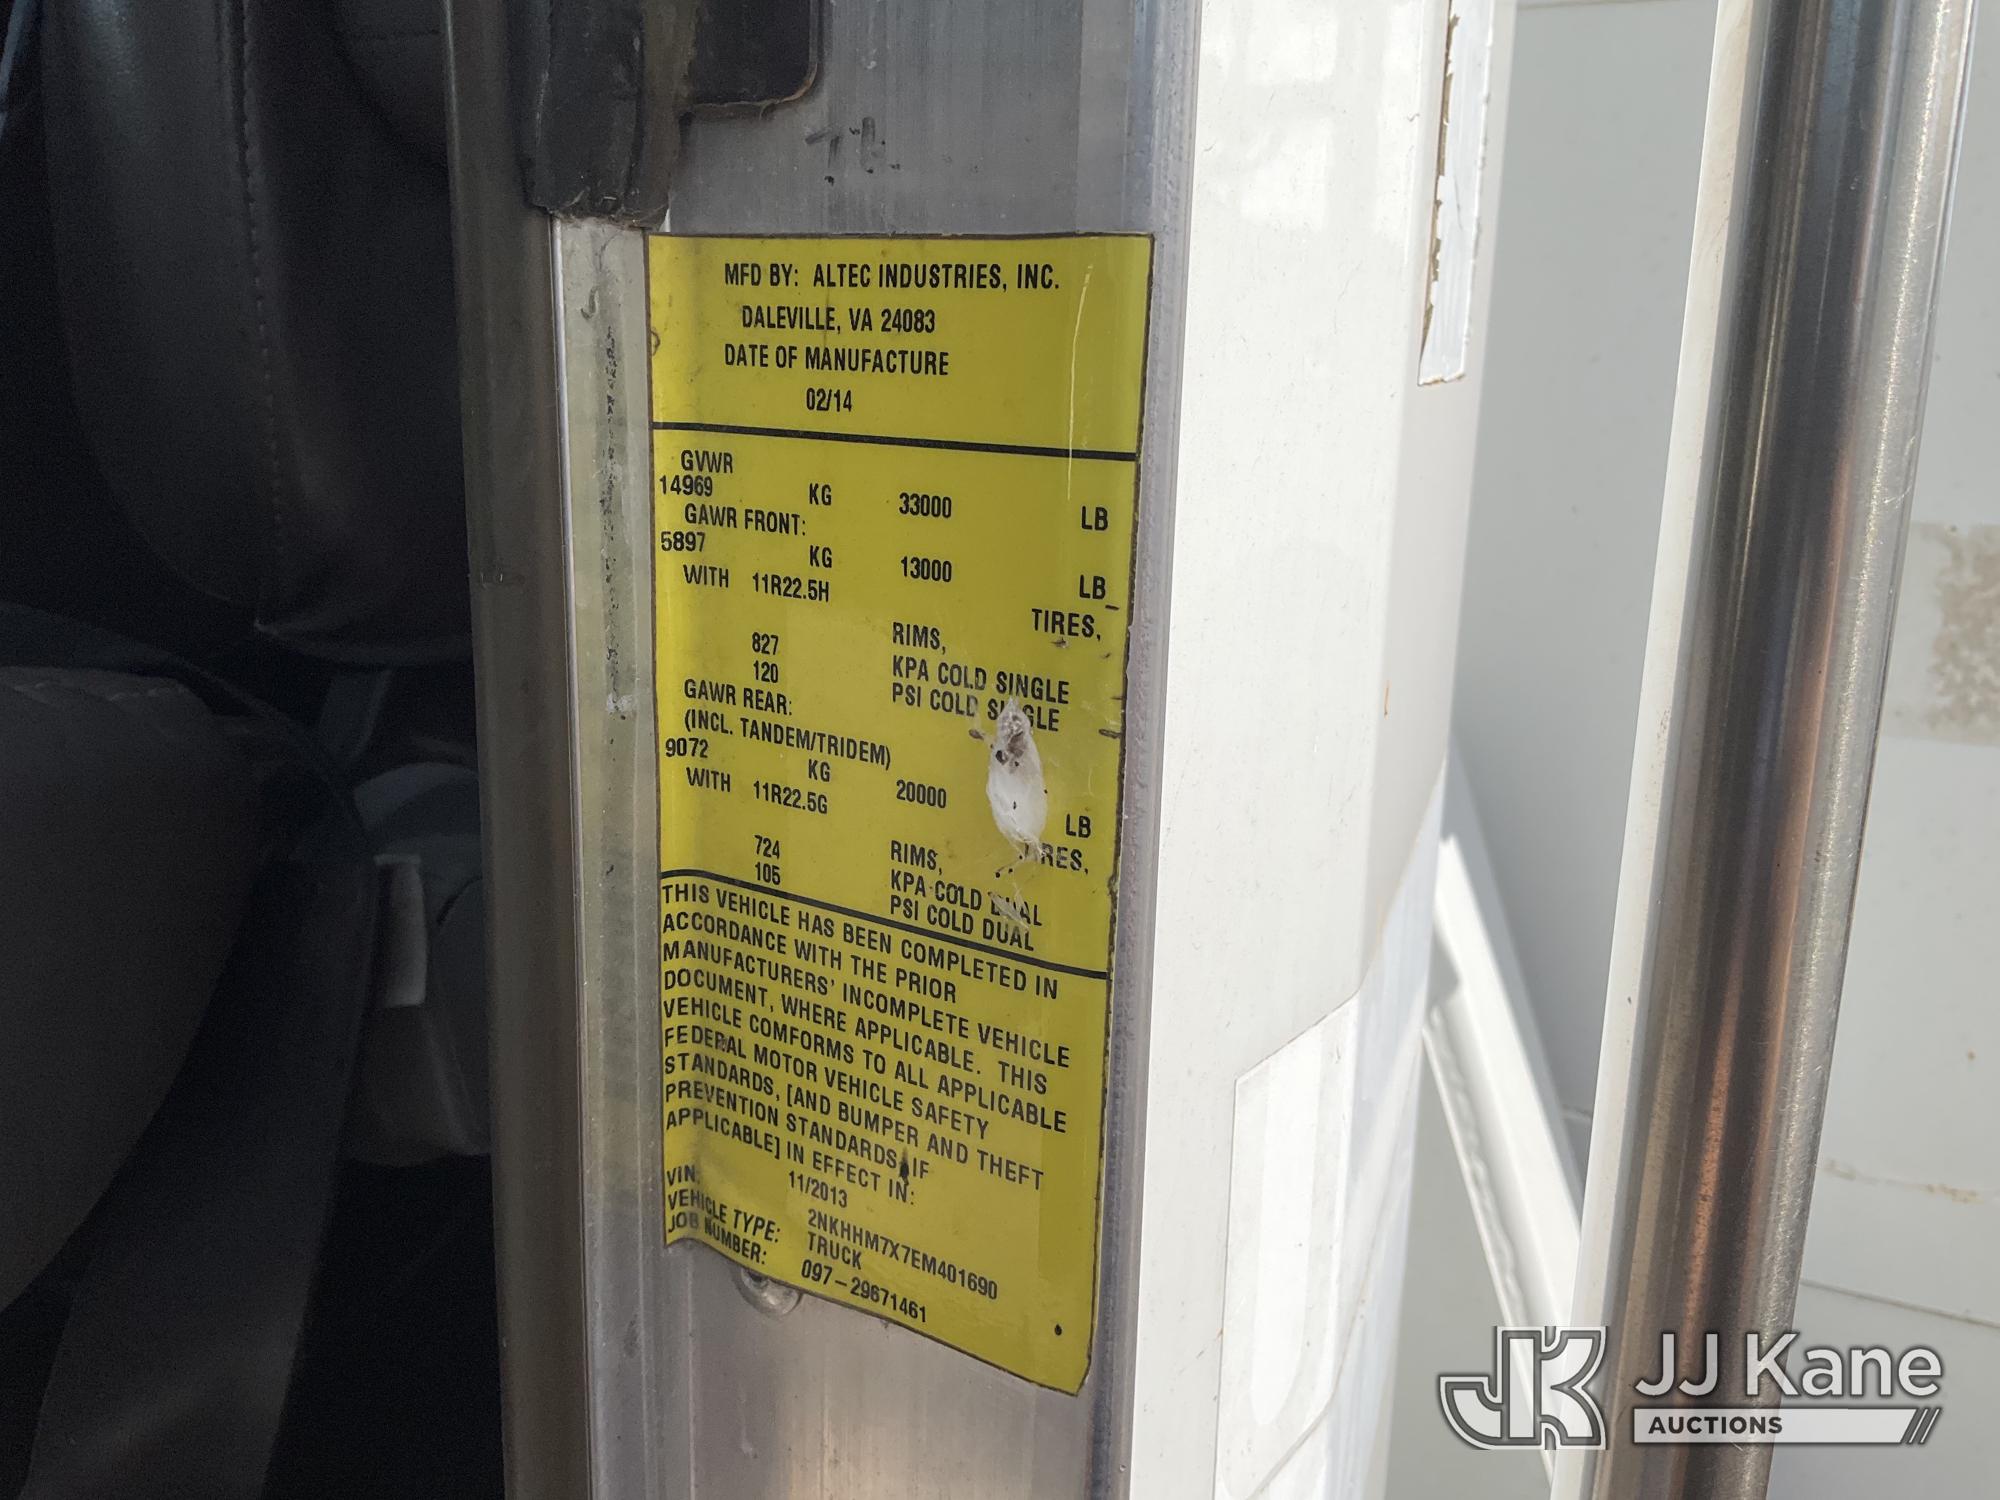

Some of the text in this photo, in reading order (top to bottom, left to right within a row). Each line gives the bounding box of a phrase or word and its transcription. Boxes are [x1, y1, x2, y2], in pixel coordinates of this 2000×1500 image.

[724, 263, 1060, 293] MFD BY: ALTEC INDUSTRIES, INC.
[742, 305, 936, 334] DALEVILLE, VA 24083
[724, 344, 950, 376] DATE OF MANUFACTURE
[806, 388, 853, 412] 02/14
[681, 449, 734, 474] GVWR
[660, 476, 1109, 531] 14969 KG 33000 LB
[685, 503, 806, 536] GAWR FRONT:
[661, 531, 1106, 600] 5897 KG 13000 LB
[683, 565, 1101, 641] WITH 11R22.5H TIRES,
[893, 622, 946, 653] RIMS,
[684, 679, 792, 715] GAWR REAR:
[752, 633, 1069, 705] 827 KPA COLD SINGLE
[753, 661, 1060, 732] 120 PSI COLD SIGLE
[684, 709, 892, 771] (INCL. TANDEM/TRIDEM)
[665, 737, 1092, 839] 9072 KG 20000 LB
[686, 767, 731, 793] WITH
[753, 781, 829, 815] 11R22.5G
[754, 835, 1043, 927] 724 KPA COLD AL
[890, 841, 943, 876] RIMS,
[662, 883, 1058, 1000] THIS VEHICLE HAS BEEN COMPLETED IN
[755, 862, 1035, 952] 105 PSI COLD DUAL
[662, 911, 957, 1004] ACCORDANCE WITH THE PRIOR
[664, 968, 1048, 1095] DOCUMENT, WHERE APPLICABLE. THIS
[843, 983, 969, 1039] INCOMPLETE
[977, 1022, 1070, 1068] VEHICLE
[664, 996, 1067, 1133] VEHICLE COMFORMS TO ALL APPLICABLE
[664, 1025, 990, 1140] FEDERAL MOTOR VEHICLE SAFETY
[665, 1053, 1044, 1191] STANDARDS, [AND BUMPER AND THEFT
[665, 1080, 779, 1127] PREVENTION
[912, 1158, 930, 1179] IF
[666, 1108, 915, 1206] APPLICABLE] IN EFFECT IN:
[788, 1170, 848, 1208] 11/2013
[667, 1189, 862, 1270] VEHICLE TYPE: TRUCK
[667, 1212, 699, 1234] JOB
[704, 1217, 768, 1265] NUMBER:
[807, 1208, 998, 1301] 2NKHHM7X7EM401690
